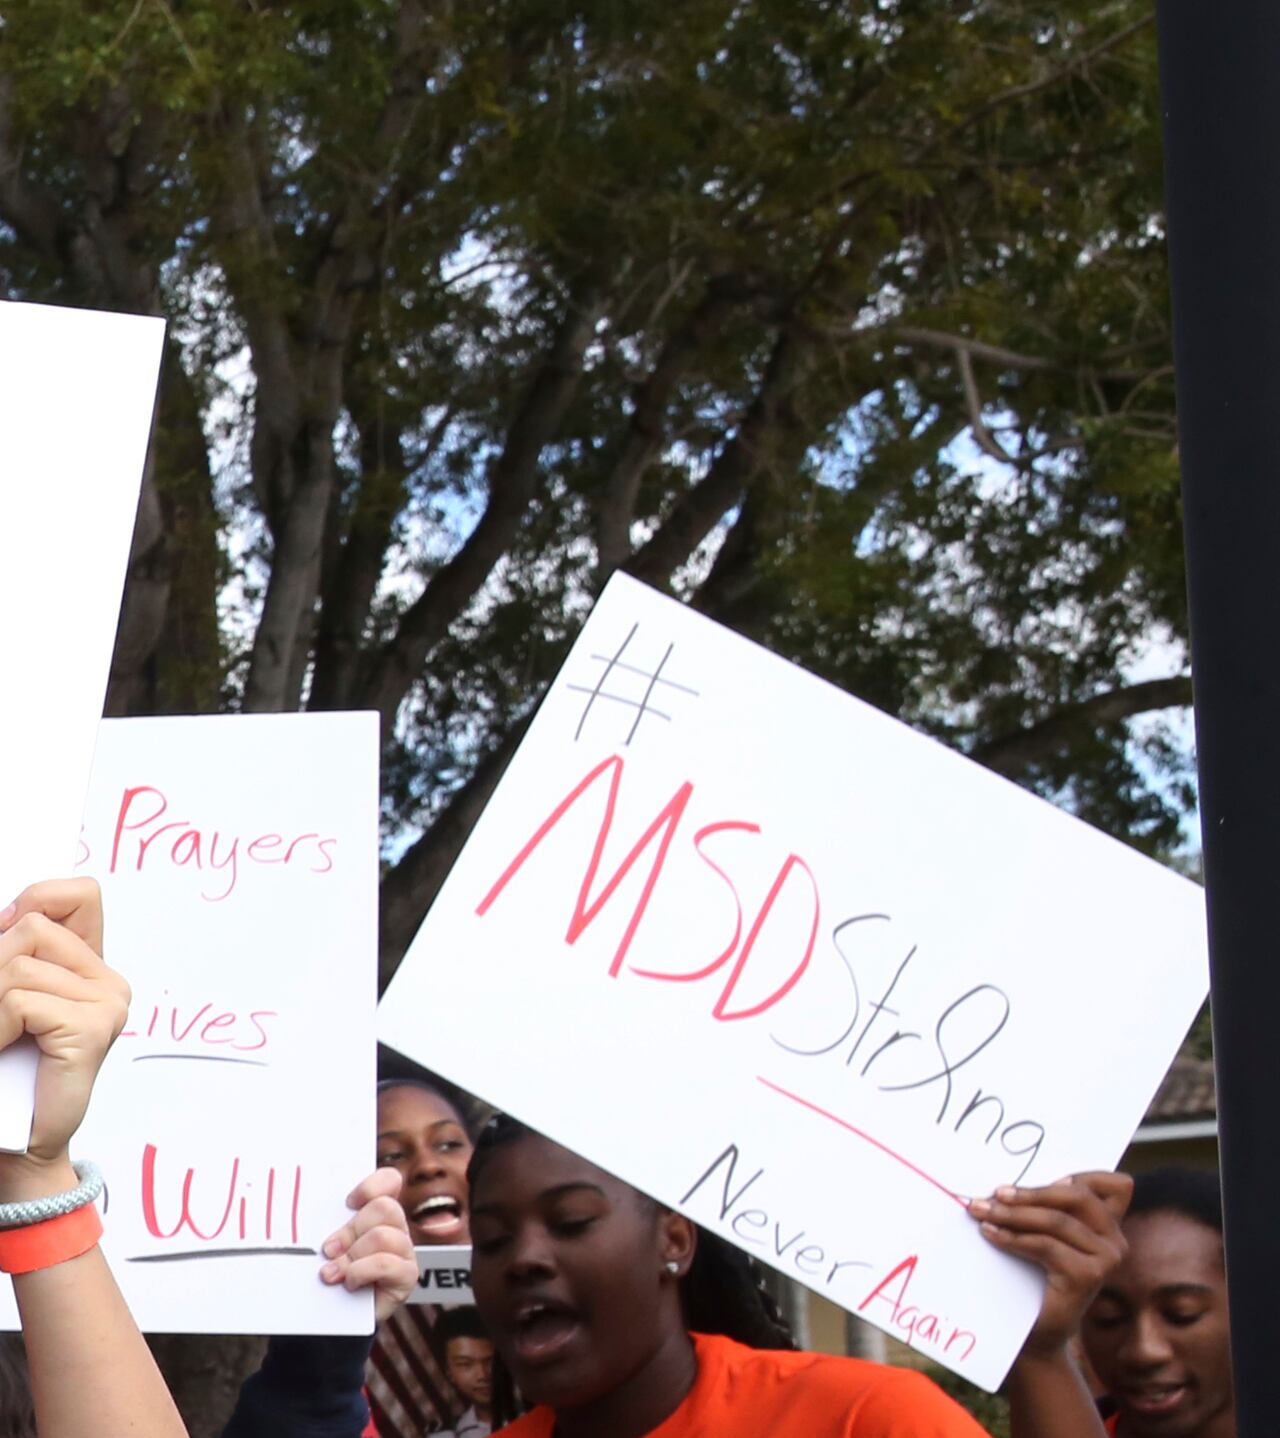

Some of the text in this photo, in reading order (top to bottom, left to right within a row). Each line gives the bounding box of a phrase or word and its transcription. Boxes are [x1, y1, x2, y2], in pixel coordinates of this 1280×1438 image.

[110, 786, 338, 901] Prayers
[142, 1144, 302, 1243] Will
[417, 1268, 473, 1289] VER
[680, 1144, 977, 1364] Never Again
